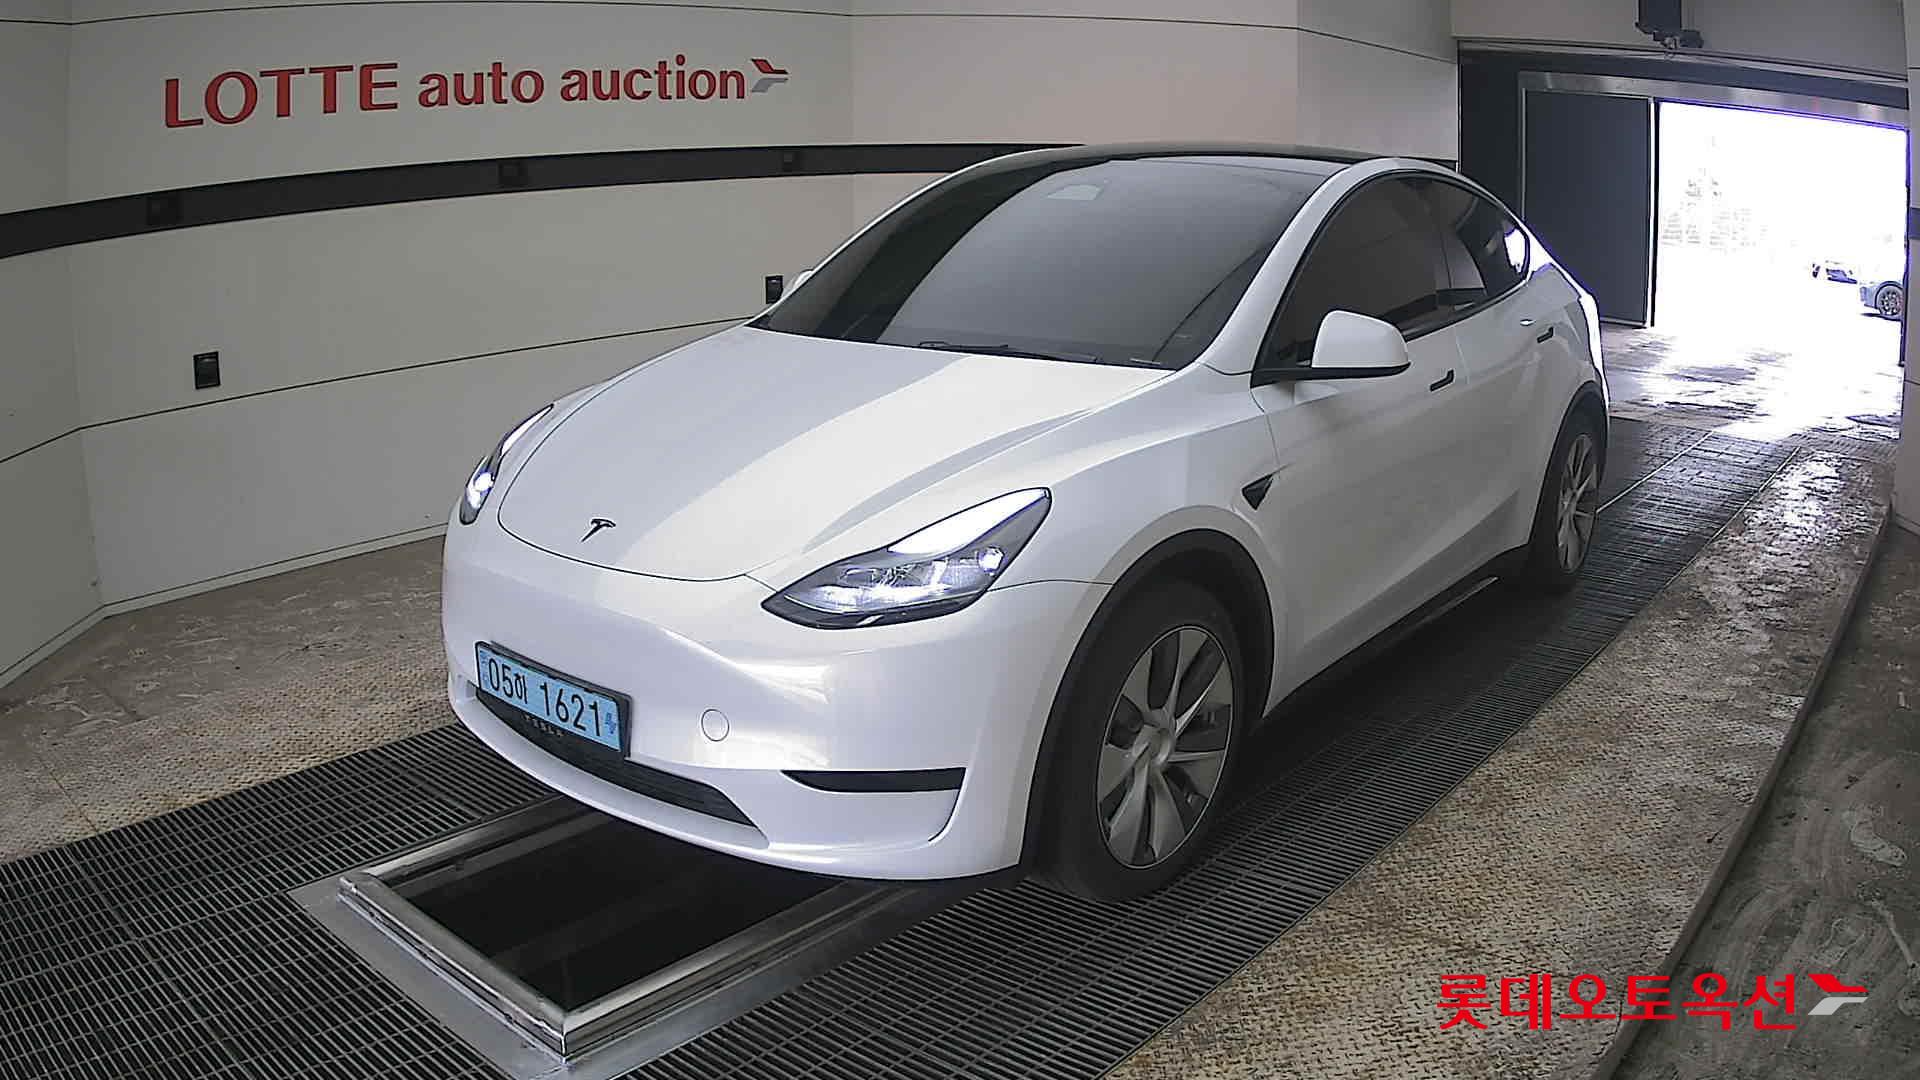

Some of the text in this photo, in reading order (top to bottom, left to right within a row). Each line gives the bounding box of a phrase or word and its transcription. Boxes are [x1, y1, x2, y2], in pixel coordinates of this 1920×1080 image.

[164, 54, 745, 128] LOTTE auto auction
[539, 682, 601, 737] 1621
